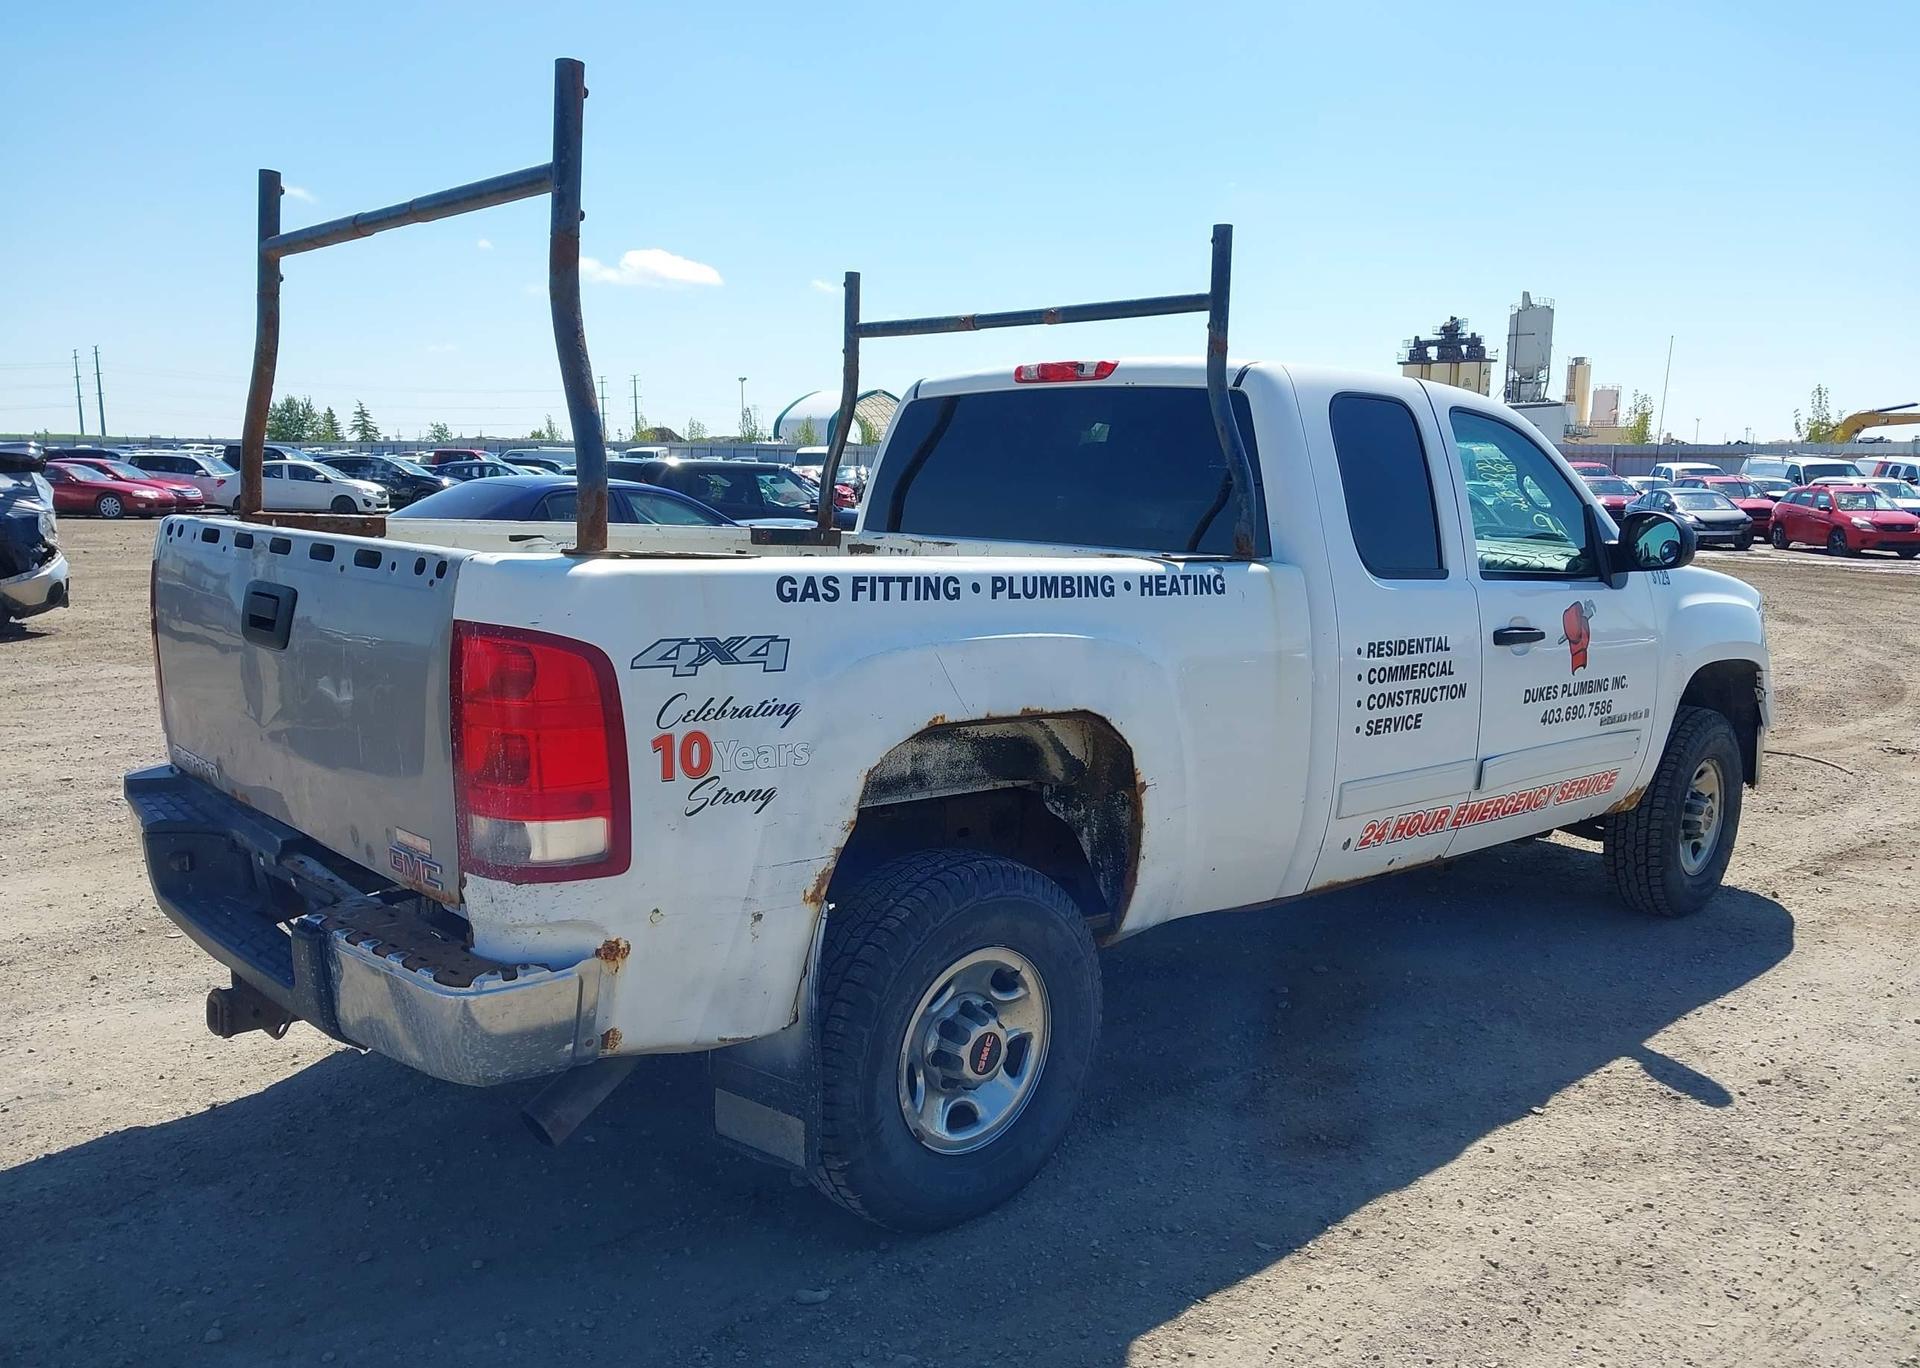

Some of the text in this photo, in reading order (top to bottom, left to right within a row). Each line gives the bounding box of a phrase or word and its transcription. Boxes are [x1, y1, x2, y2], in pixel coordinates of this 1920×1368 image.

[776, 574, 1226, 603] GAS FITTING PLUMBING HEATING
[1366, 635, 1451, 659] RESIDENTIAL
[1367, 660, 1454, 685] COMMERCIAL
[1366, 683, 1467, 711] CONSTRUCTION
[1523, 675, 1629, 705] DUKES PLUMBING INC.
[656, 693, 802, 729] Celebrating
[1365, 712, 1423, 737] SERVICE
[1540, 699, 1613, 726] 403.690.7586
[651, 730, 811, 782] 10 Years
[684, 775, 778, 817] Strong
[1355, 768, 1621, 851] 24 HOUR EMERGENCY SERVICE
[389, 846, 443, 891] GMC
[977, 1034, 994, 1073] GMC
